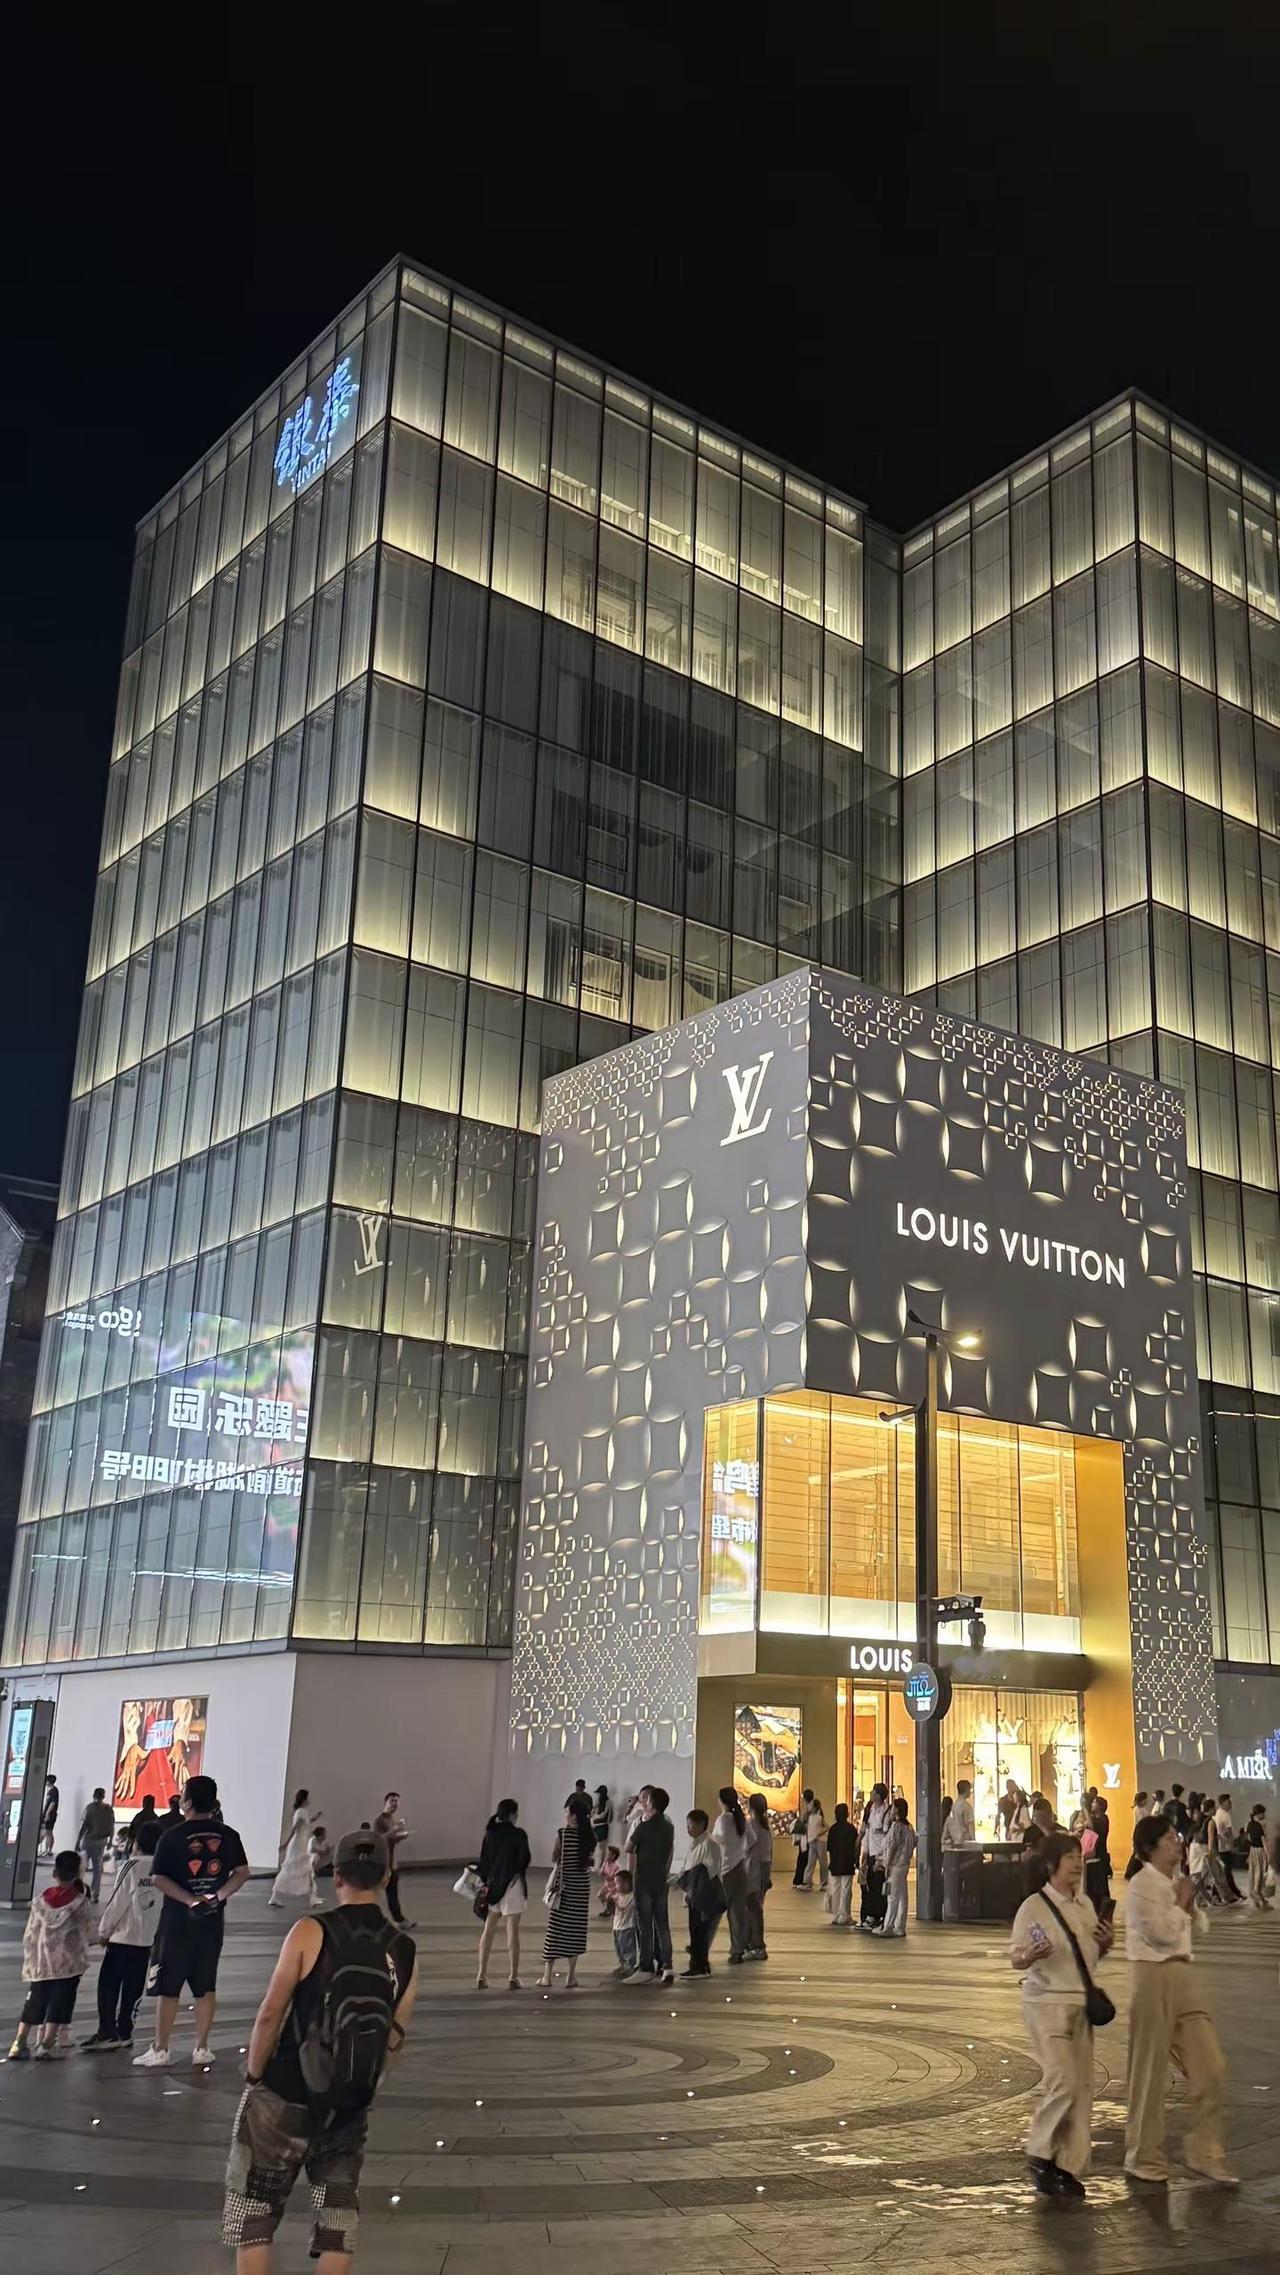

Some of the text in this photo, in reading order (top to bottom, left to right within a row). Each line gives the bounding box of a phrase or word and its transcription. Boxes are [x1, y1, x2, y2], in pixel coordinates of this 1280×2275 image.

[719, 1050, 775, 1147] LV
[353, 1199, 393, 1276] LV
[896, 1202, 1126, 1289] LOUIS VUITTON
[850, 1645, 913, 1673] LOUIS
